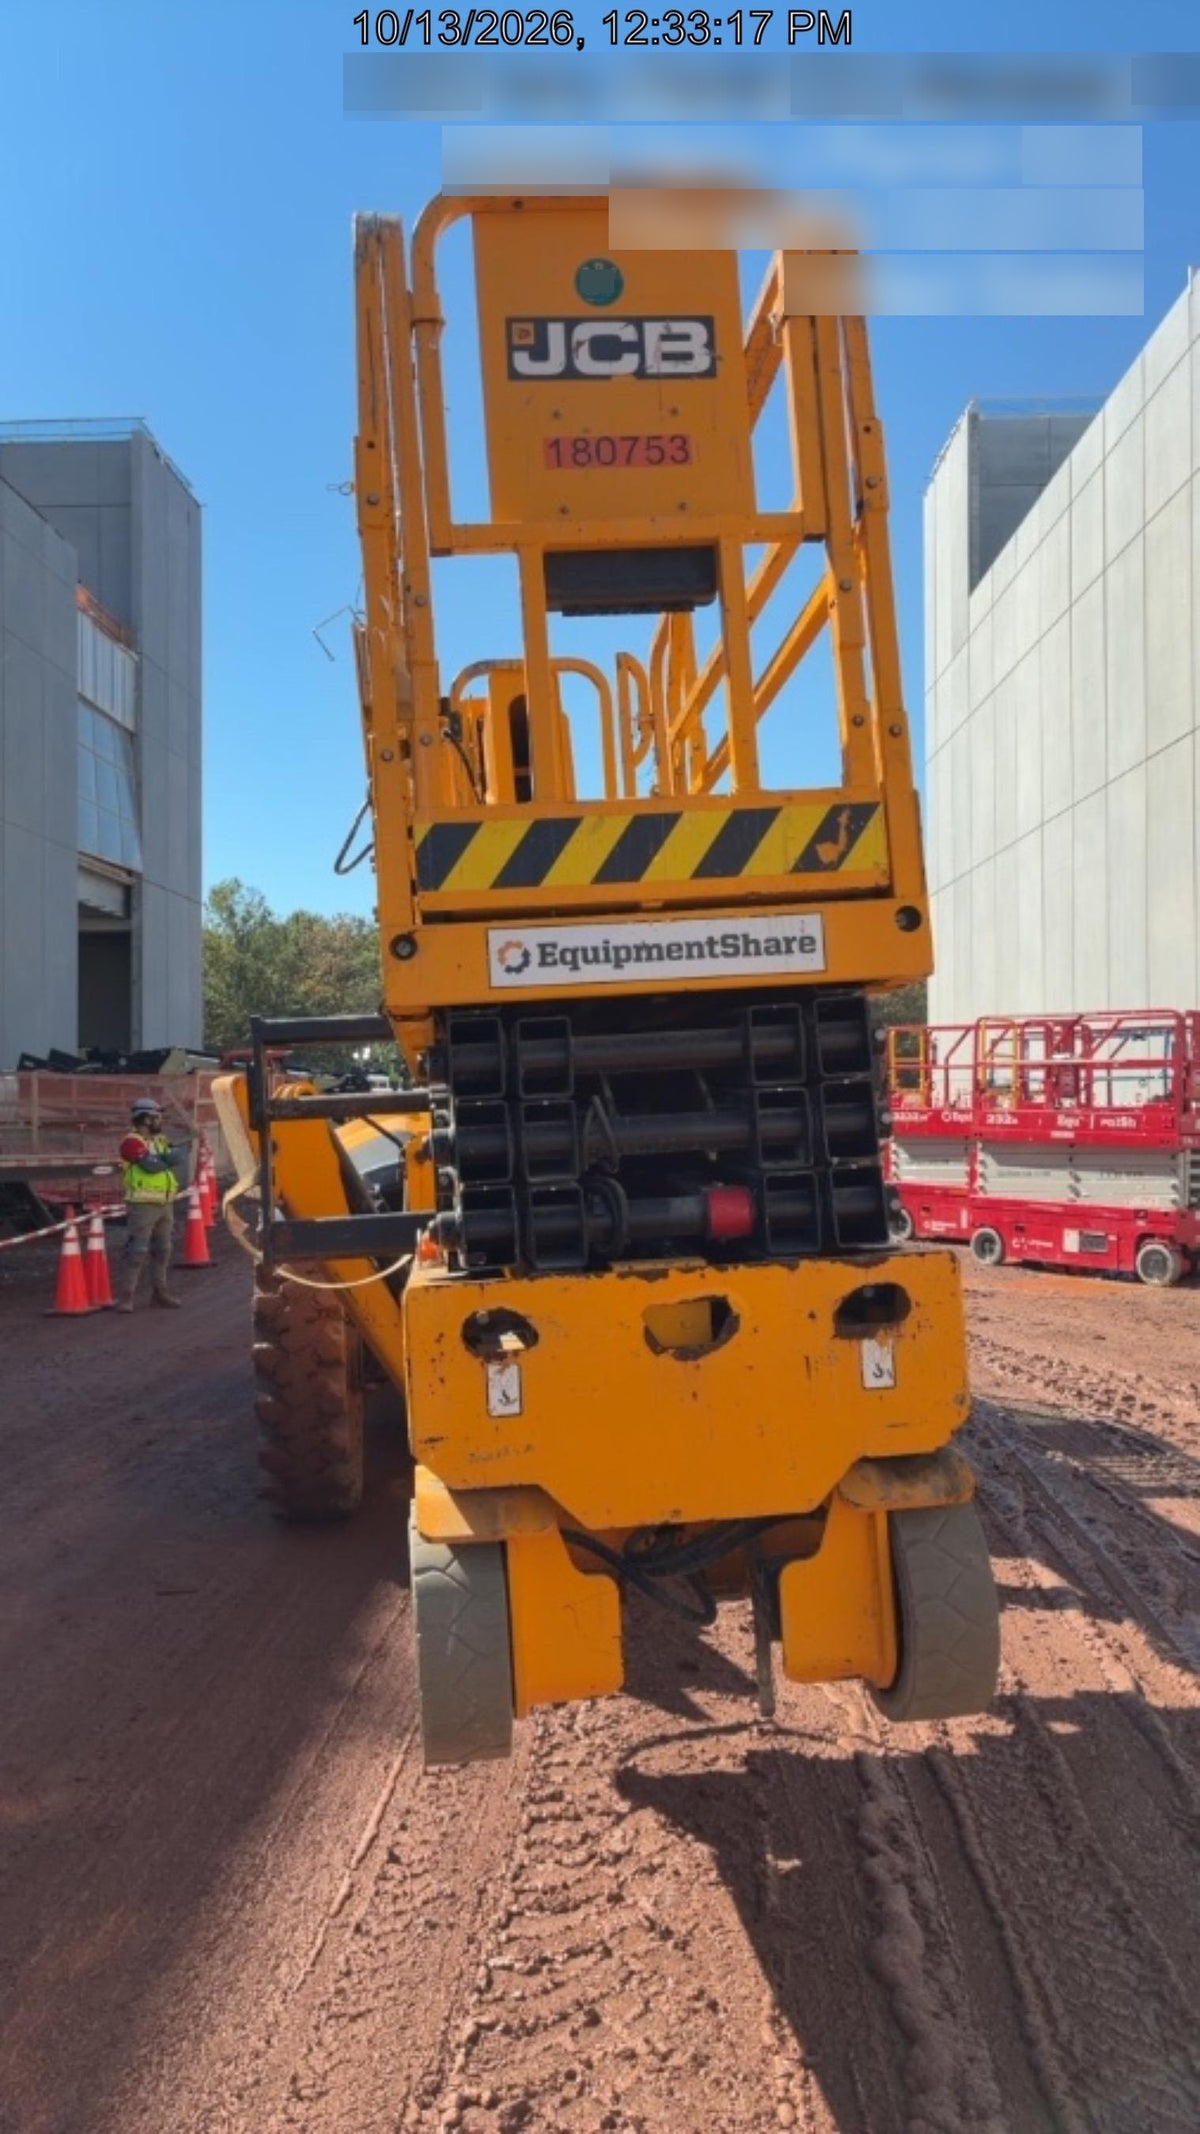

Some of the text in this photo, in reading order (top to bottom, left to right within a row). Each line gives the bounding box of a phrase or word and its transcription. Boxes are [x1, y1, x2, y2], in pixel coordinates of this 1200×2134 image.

[512, 321, 712, 376] JCB
[547, 433, 690, 468] 180753
[536, 933, 817, 972] EquipmentShare
